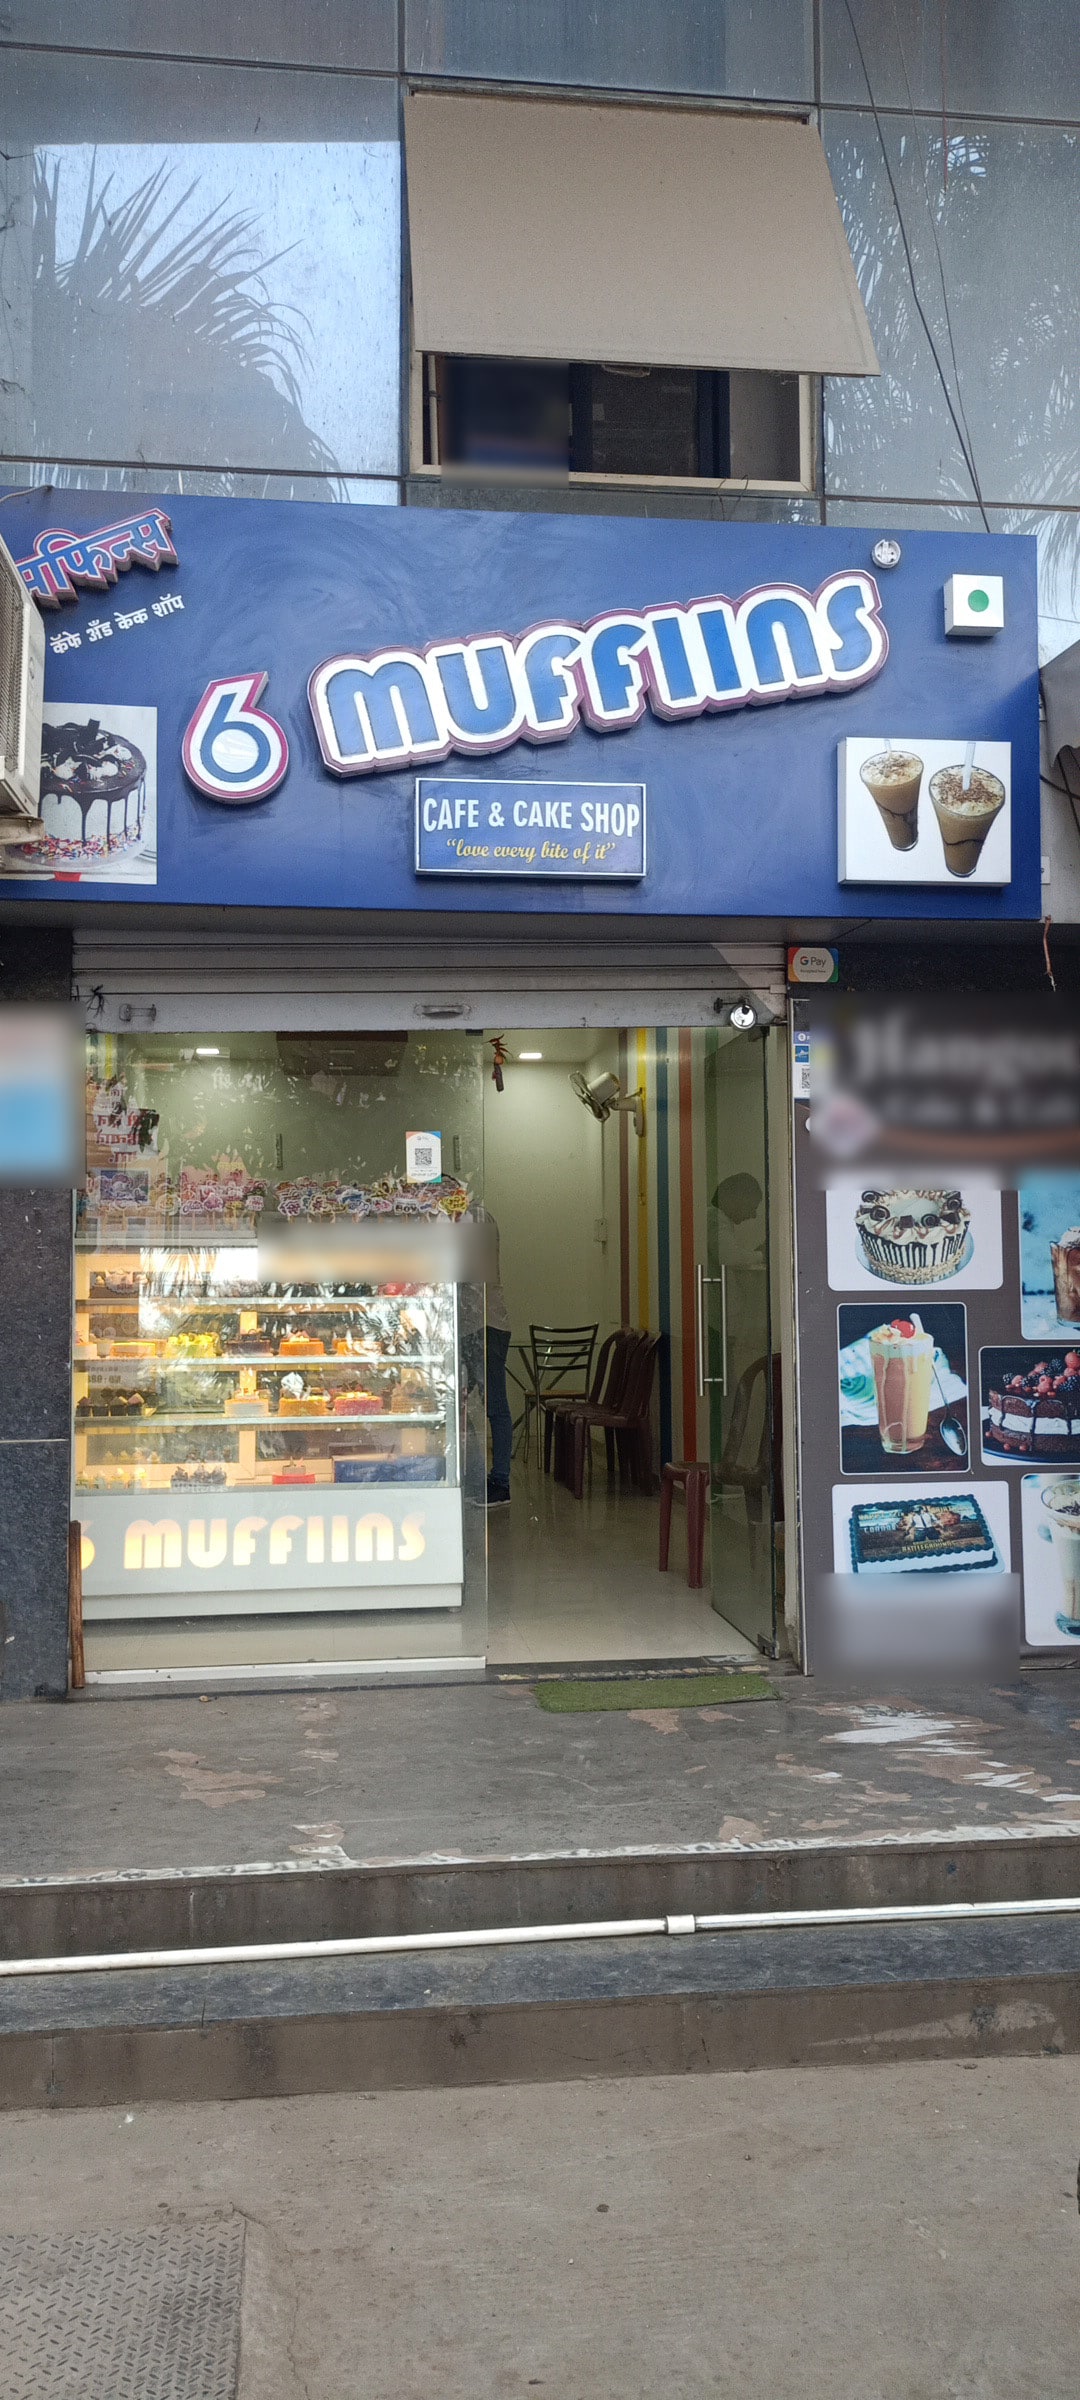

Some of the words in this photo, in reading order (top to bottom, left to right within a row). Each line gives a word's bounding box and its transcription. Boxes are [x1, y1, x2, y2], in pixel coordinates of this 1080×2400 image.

[50, 631, 82, 654] कॅफे
[114, 608, 148, 630] केक
[152, 593, 185, 617] शॉप
[188, 680, 284, 796] 6
[317, 577, 880, 767] MUFFIINS
[423, 797, 479, 832] CAFE
[488, 801, 505, 827] &
[513, 800, 572, 829] CAKE
[581, 801, 640, 837] SHOP
[494, 844, 536, 863] every
[541, 840, 569, 859] bite
[573, 842, 590, 864] of
[810, 956, 826, 967] Pay
[123, 1512, 426, 1569] MUFFIINS
